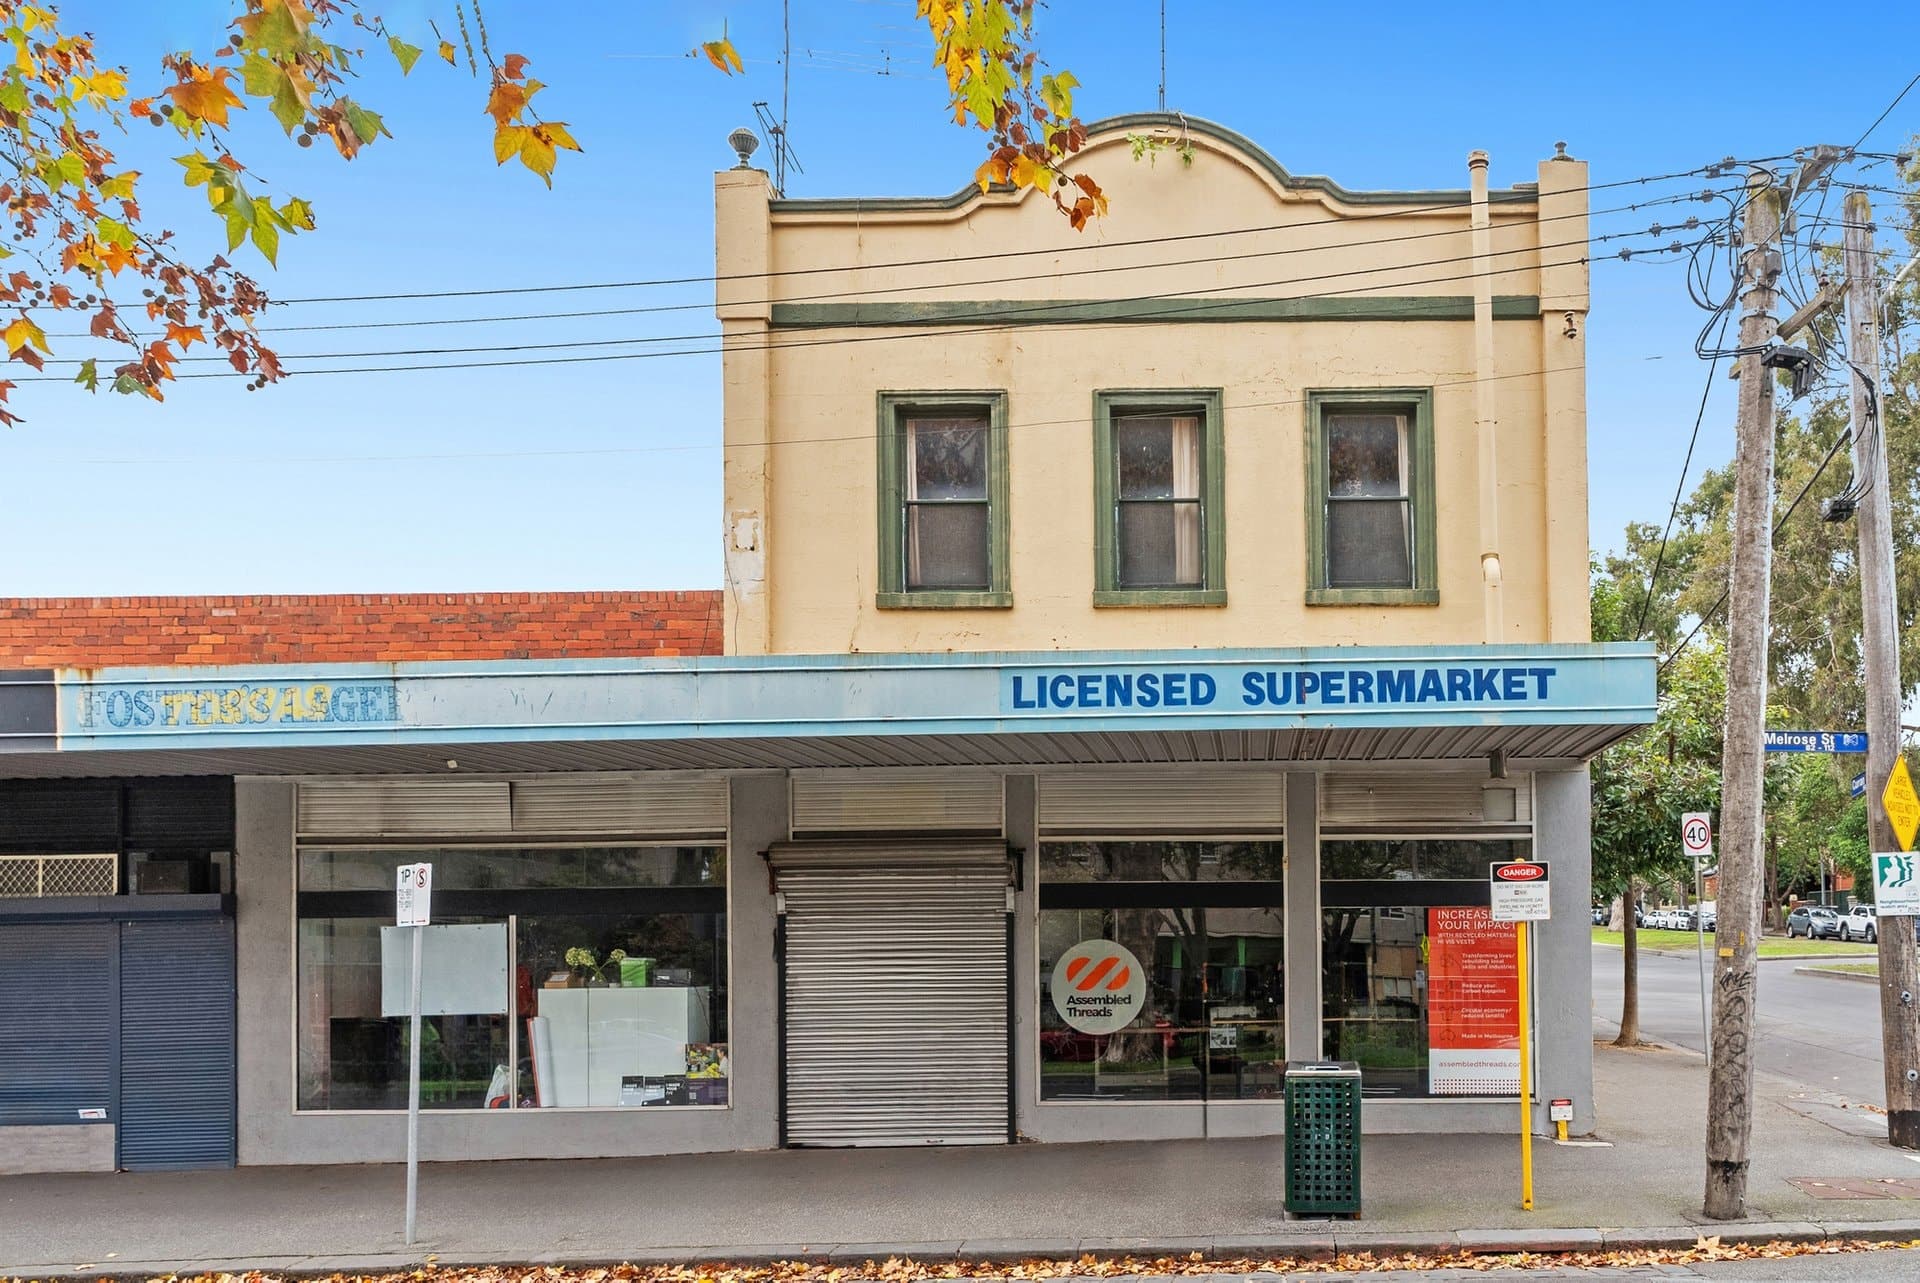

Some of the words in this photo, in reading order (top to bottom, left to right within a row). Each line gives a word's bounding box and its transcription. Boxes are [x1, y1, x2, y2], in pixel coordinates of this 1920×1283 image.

[1012, 671, 1217, 709] LICENSED
[1242, 667, 1557, 706] SUPERMARKET
[1764, 732, 1817, 745] Melrose
[1821, 732, 1836, 745] St
[1686, 826, 1707, 842] 40
[400, 868, 411, 883] 1P
[1503, 868, 1538, 876] DANGER
[1438, 921, 1470, 930] YOUR
[1474, 921, 1516, 930] IMPACT
[1066, 994, 1132, 1005] Assembled
[1066, 1007, 1113, 1017] Threads
